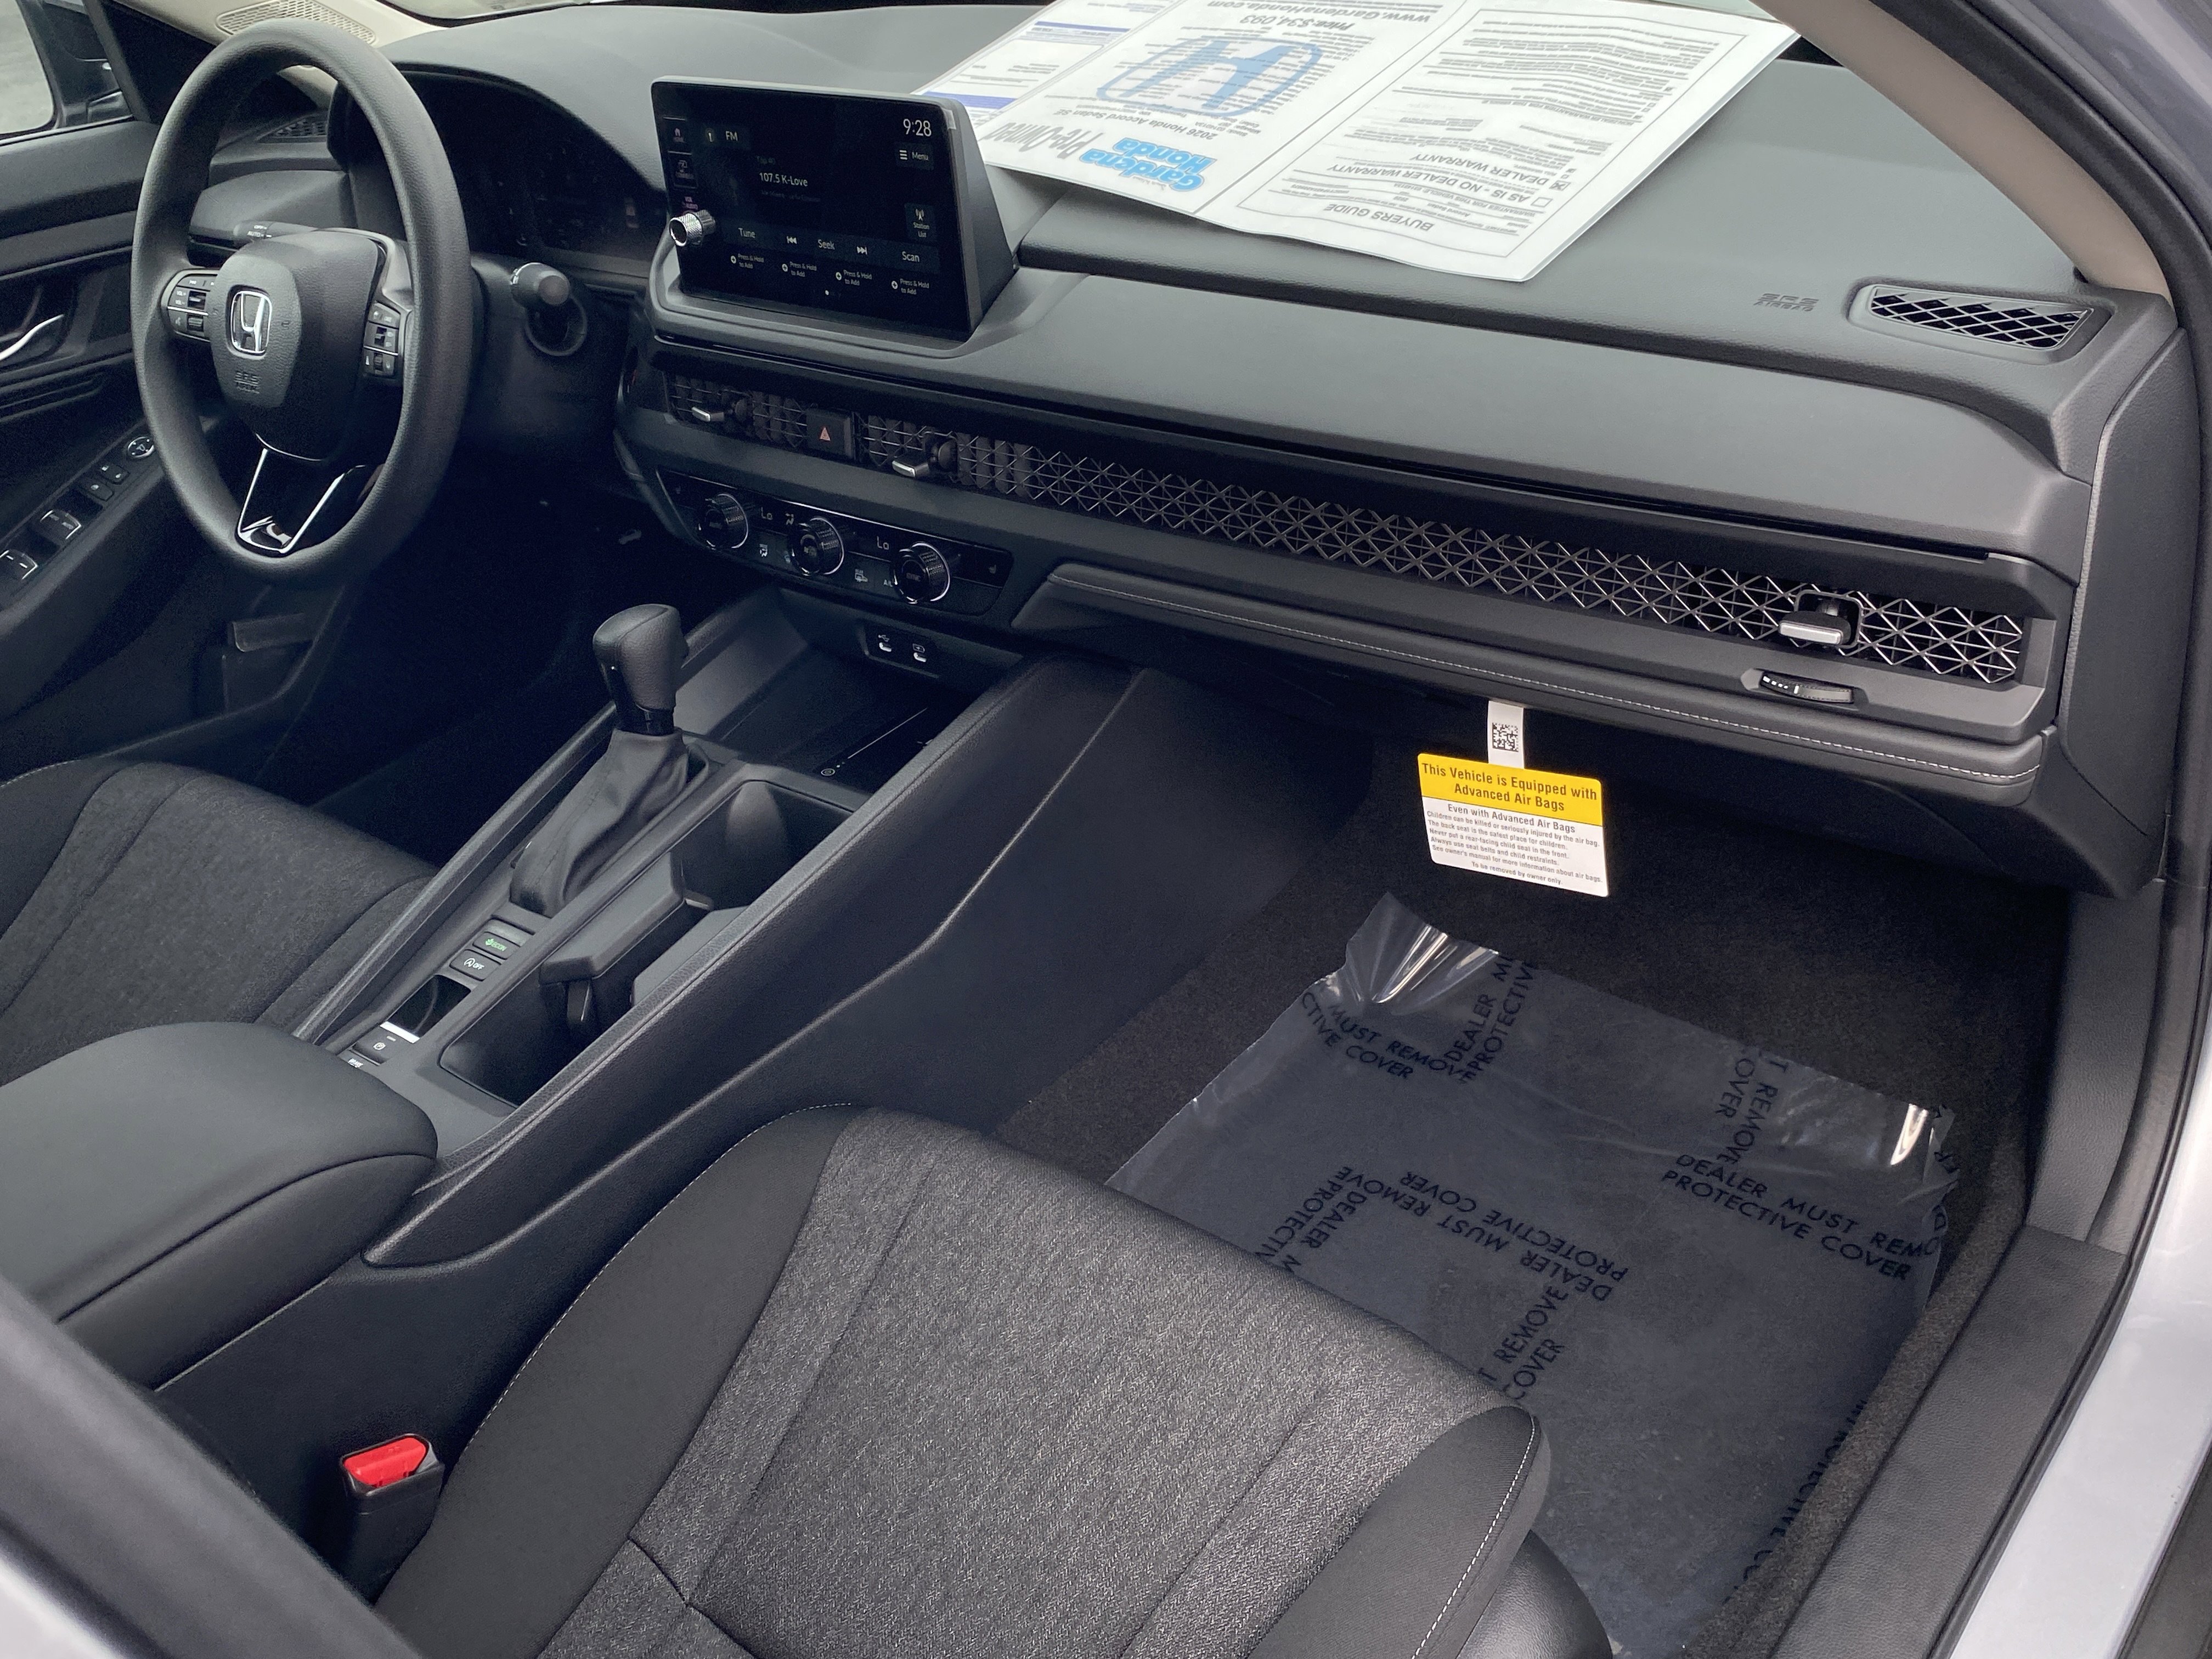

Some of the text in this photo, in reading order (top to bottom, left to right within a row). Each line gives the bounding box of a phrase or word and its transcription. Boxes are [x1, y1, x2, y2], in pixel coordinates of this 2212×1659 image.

[1075, 110, 1107, 119] Sedan
[1105, 114, 1149, 125] Accord
[903, 119, 932, 137] 9:28
[1149, 120, 1188, 133] Honda
[1188, 128, 1218, 140] 2026
[725, 131, 738, 141] FM
[977, 123, 1103, 159] Pre-Owned
[911, 151, 929, 161] Menu
[1113, 137, 1217, 173] Honda
[1409, 154, 1489, 172] WARRANTY
[1079, 148, 1205, 192] Gardena
[1326, 164, 1401, 177] WARRANTY
[1402, 171, 1458, 186] DEALER
[1489, 166, 1549, 185] DEALER
[759, 172, 808, 187] 107.5 K-Love
[1460, 182, 1483, 193] NO
[1491, 189, 1508, 199] IS
[1508, 193, 1530, 202] AS
[1323, 204, 1370, 217] GUIDE
[913, 222, 930, 230] Station
[1371, 211, 1434, 231] BUYERS
[737, 227, 756, 239] Tune
[817, 239, 836, 250] Seek
[901, 251, 921, 262] Scan
[900, 278, 912, 286] Press
[876, 535, 889, 550] Lo
[1421, 763, 1597, 800] This Vehicle is Equipped with
[1454, 783, 1565, 812] Advanced Air Bags
[1448, 804, 1576, 833] Even with Advanced Air Bags
[1426, 810, 1452, 821] Children
[1474, 819, 1492, 828] killed
[1500, 825, 1529, 836] seriously
[1531, 828, 1553, 838] injured
[1585, 838, 1600, 848] bag.
[1429, 828, 1447, 836] Never
[1465, 836, 1499, 847] rear-facing
[1430, 836, 1452, 845] Always
[1480, 845, 1496, 854] belts
[1489, 831, 1509, 839] safest
[1510, 834, 1527, 843] place
[1539, 839, 1568, 850] children.
[1445, 848, 1468, 856] owner's
[1469, 853, 1491, 861] manual
[1519, 861, 1555, 874] information
[1556, 868, 1574, 878] about
[1585, 874, 1603, 883] bags.
[1489, 866, 1516, 876] removed
[1526, 873, 1547, 882] owner
[1444, 994, 1497, 1063] DEALER
[1331, 1005, 1474, 1085] MUST REMOVE
[1346, 1045, 1414, 1079] COVER
[1716, 1084, 1779, 1164] REMOVE
[1677, 1154, 1859, 1234] DEALER MUST
[1300, 1191, 1367, 1249] DEALER
[1400, 1171, 1629, 1282] PROTECTIVE COVER
[1662, 1170, 1910, 1280] PROTECTIVE COVER
[1335, 1166, 1613, 1301] DEALER MUST REMOVE
[1494, 1285, 1570, 1364] REMOVE
